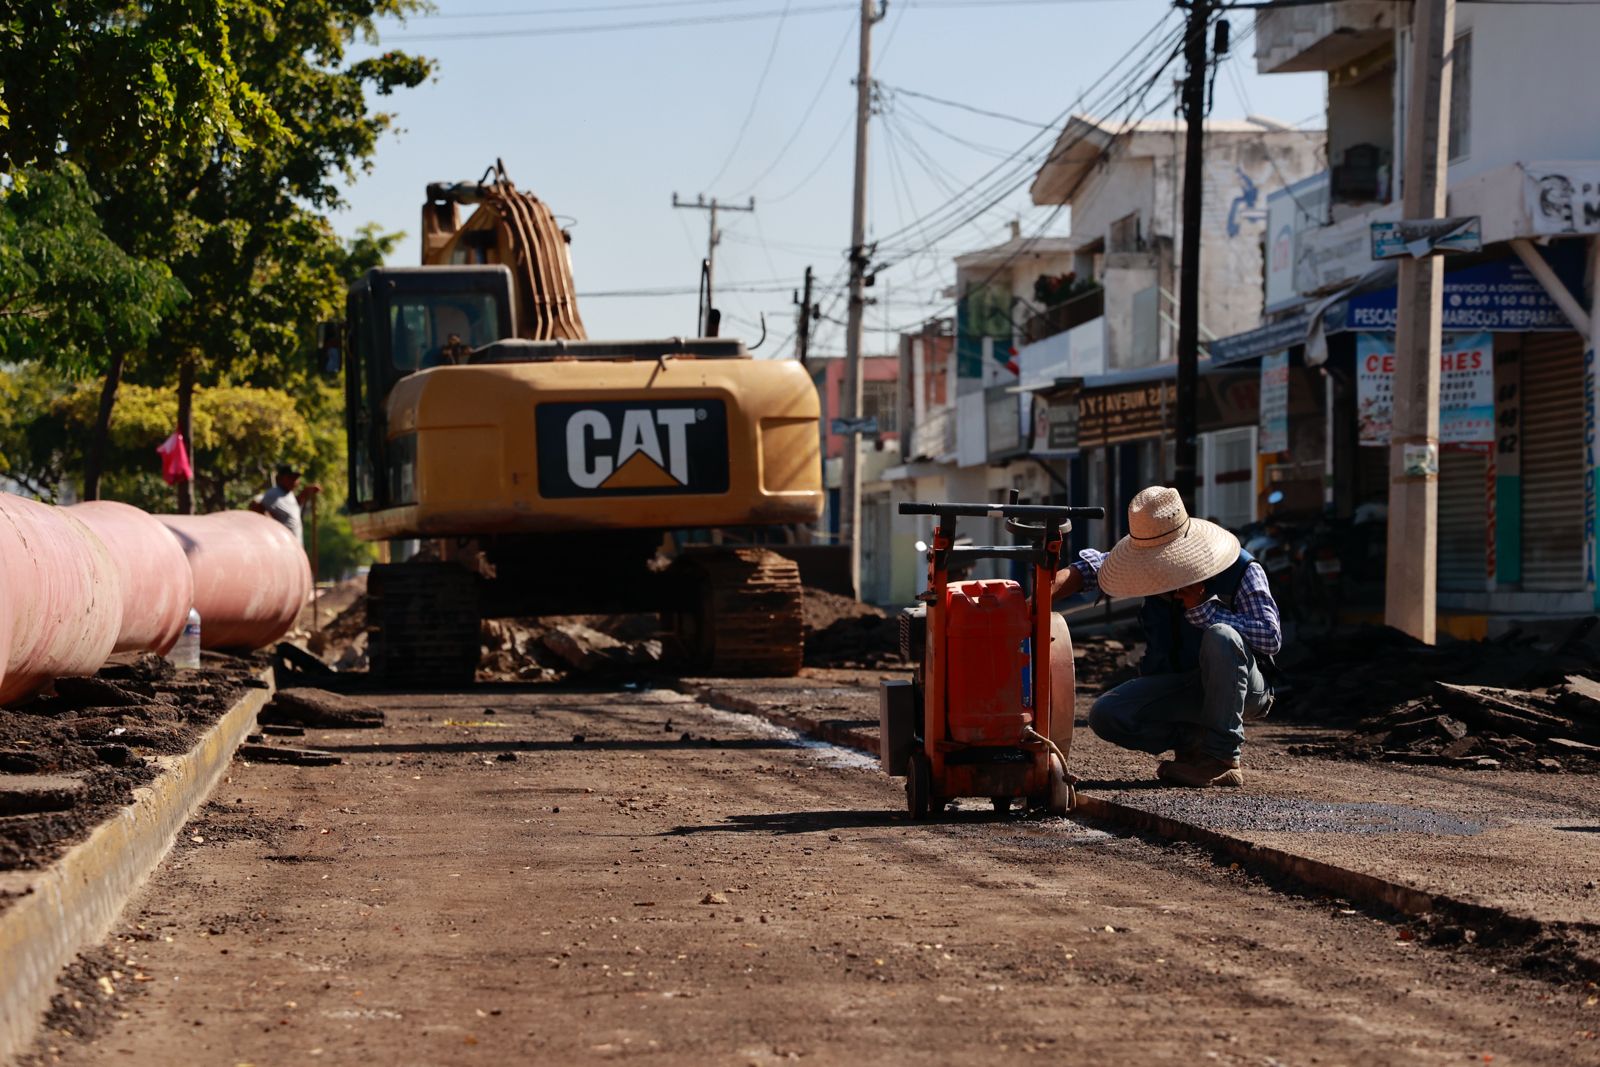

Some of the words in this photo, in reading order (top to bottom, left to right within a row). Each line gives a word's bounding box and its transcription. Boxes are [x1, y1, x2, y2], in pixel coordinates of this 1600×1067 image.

[1489, 283, 1497, 293] A
[1465, 294, 1490, 306] 669
[1493, 294, 1517, 306] 160
[1354, 307, 1397, 325] PESCAD
[565, 408, 696, 489] CAT
